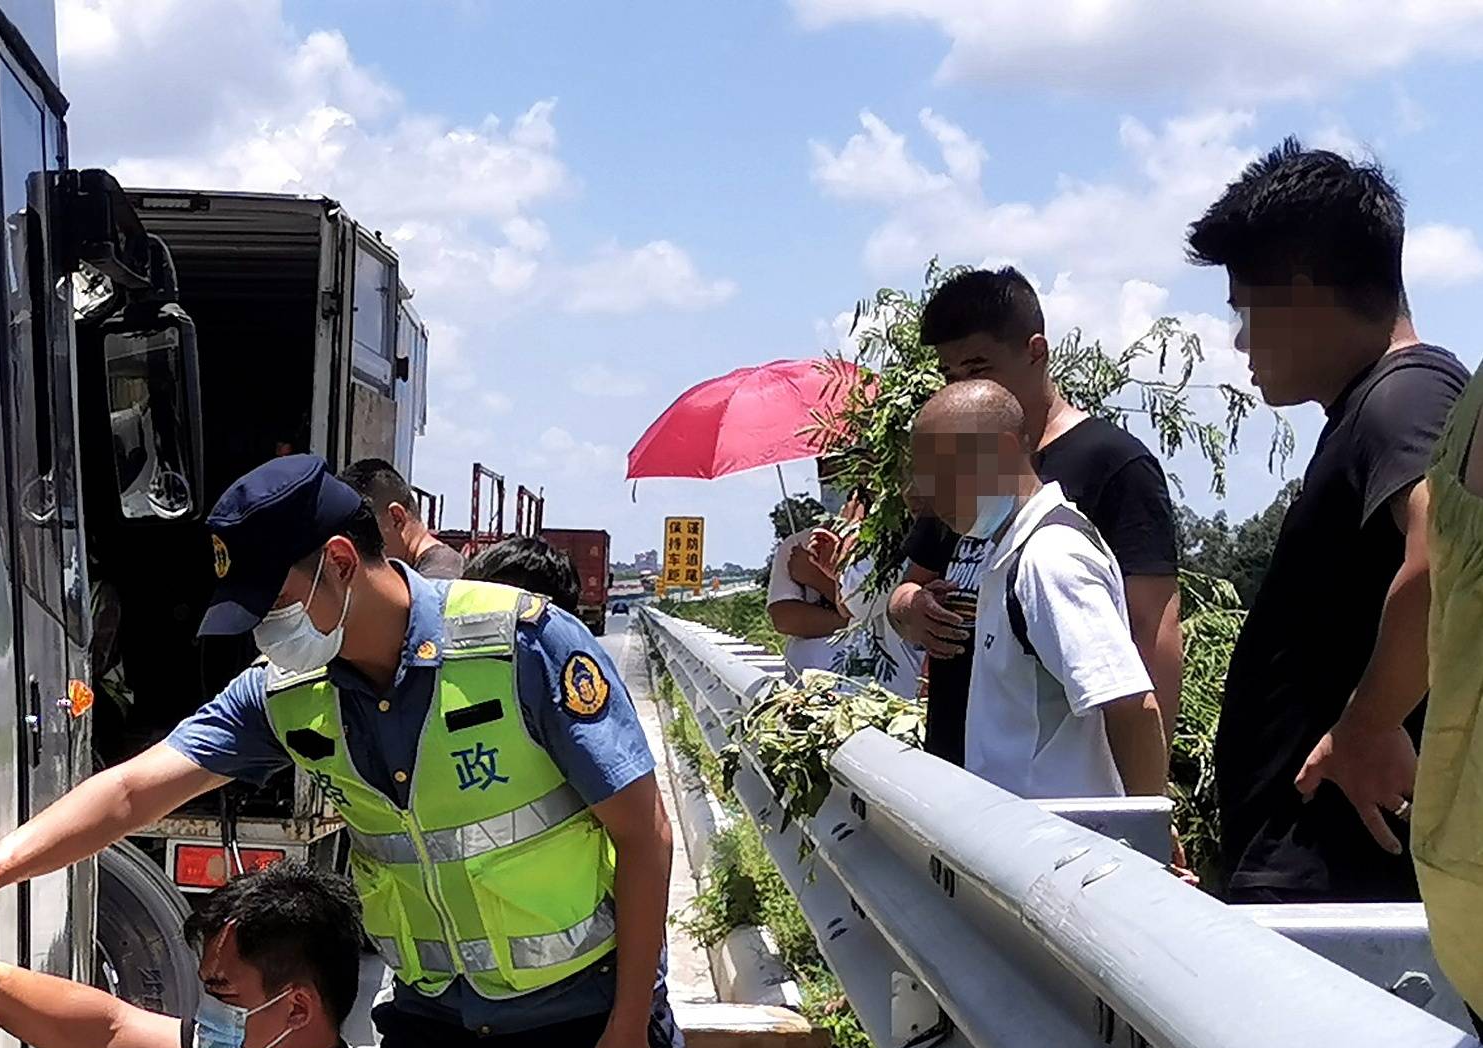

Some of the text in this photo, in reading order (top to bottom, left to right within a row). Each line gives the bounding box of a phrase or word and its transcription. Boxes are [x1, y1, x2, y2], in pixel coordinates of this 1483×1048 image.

[667, 521, 681, 582] 保持车距
[450, 742, 510, 791] 政
